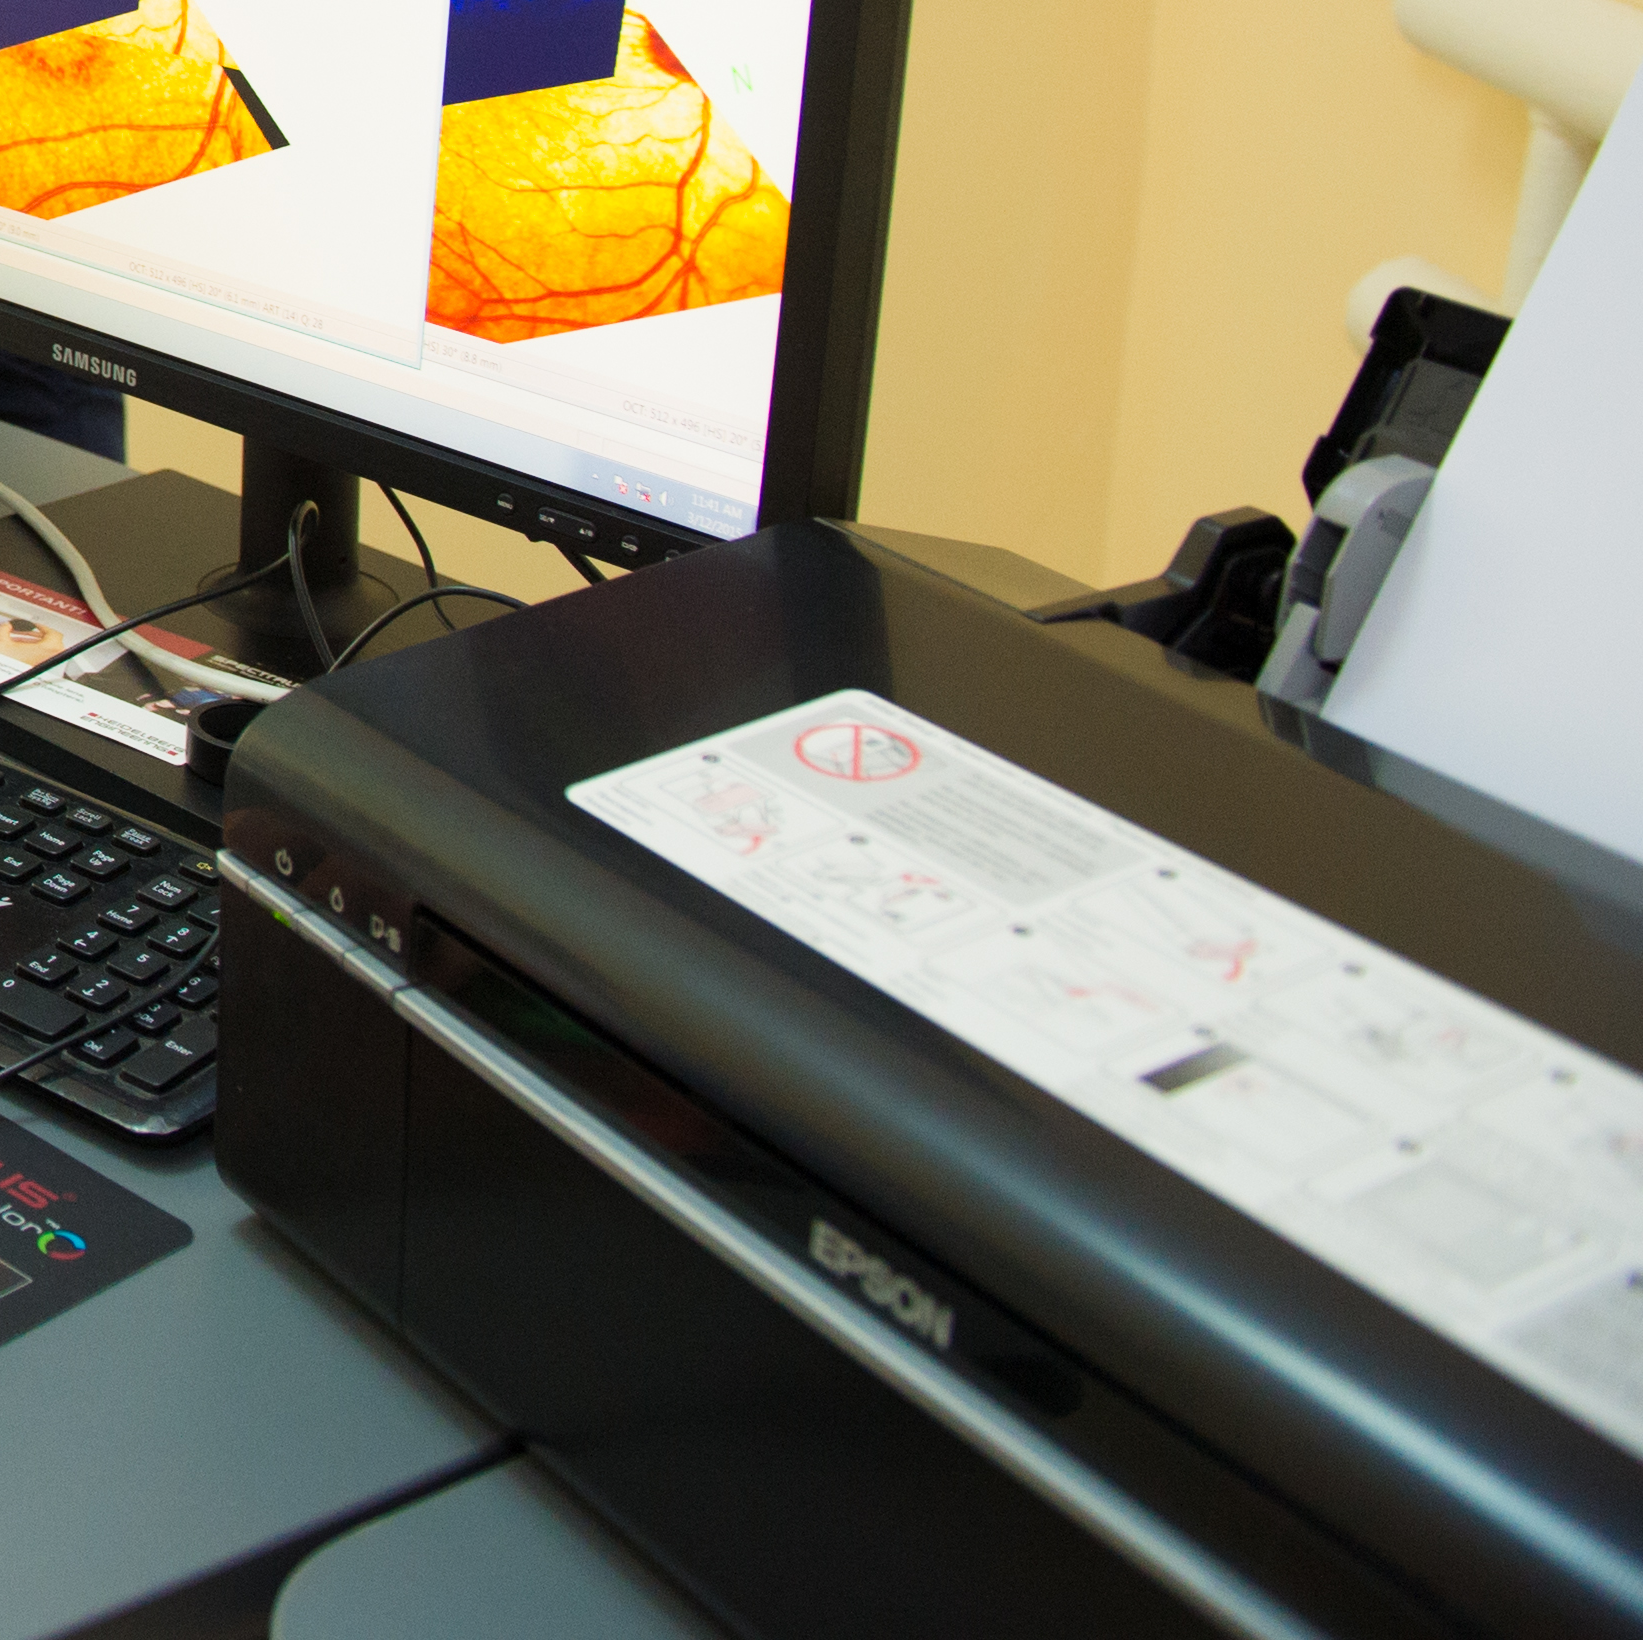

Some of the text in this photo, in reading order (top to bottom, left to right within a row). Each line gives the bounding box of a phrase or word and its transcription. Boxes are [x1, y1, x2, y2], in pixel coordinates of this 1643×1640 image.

[128, 261, 148, 275] OCT:
[149, 267, 164, 281] 512
[262, 301, 280, 316] ART
[52, 343, 137, 387] SAMSUNG
[621, 399, 647, 417] OCT:
[649, 408, 669, 424] 512
[680, 417, 700, 433] 496
[691, 493, 743, 520] 11:41 AM
[79, 715, 167, 753] ENGINEERING
[96, 714, 185, 753] HEIDELBERG
[73, 812, 93, 824] Lock
[76, 808, 103, 821] Scroll
[39, 831, 65, 847] Home
[3, 856, 23, 868] End
[88, 856, 103, 867] Up
[92, 849, 115, 864] Page
[42, 878, 69, 893] Down
[53, 873, 76, 888] Page
[161, 879, 182, 895] Num
[151, 884, 175, 899] Lock
[126, 905, 141, 914] 7
[106, 910, 133, 925] Home
[86, 930, 99, 939] 4
[176, 927, 190, 936] 8
[47, 955, 57, 964] 1
[136, 953, 150, 963] 5
[28, 961, 50, 974] End
[2, 979, 15, 988] 0
[95, 979, 110, 989] 2
[84, 1040, 104, 1053] Del
[165, 1040, 193, 1057] Enter
[809, 1218, 954, 1350] EPSON
